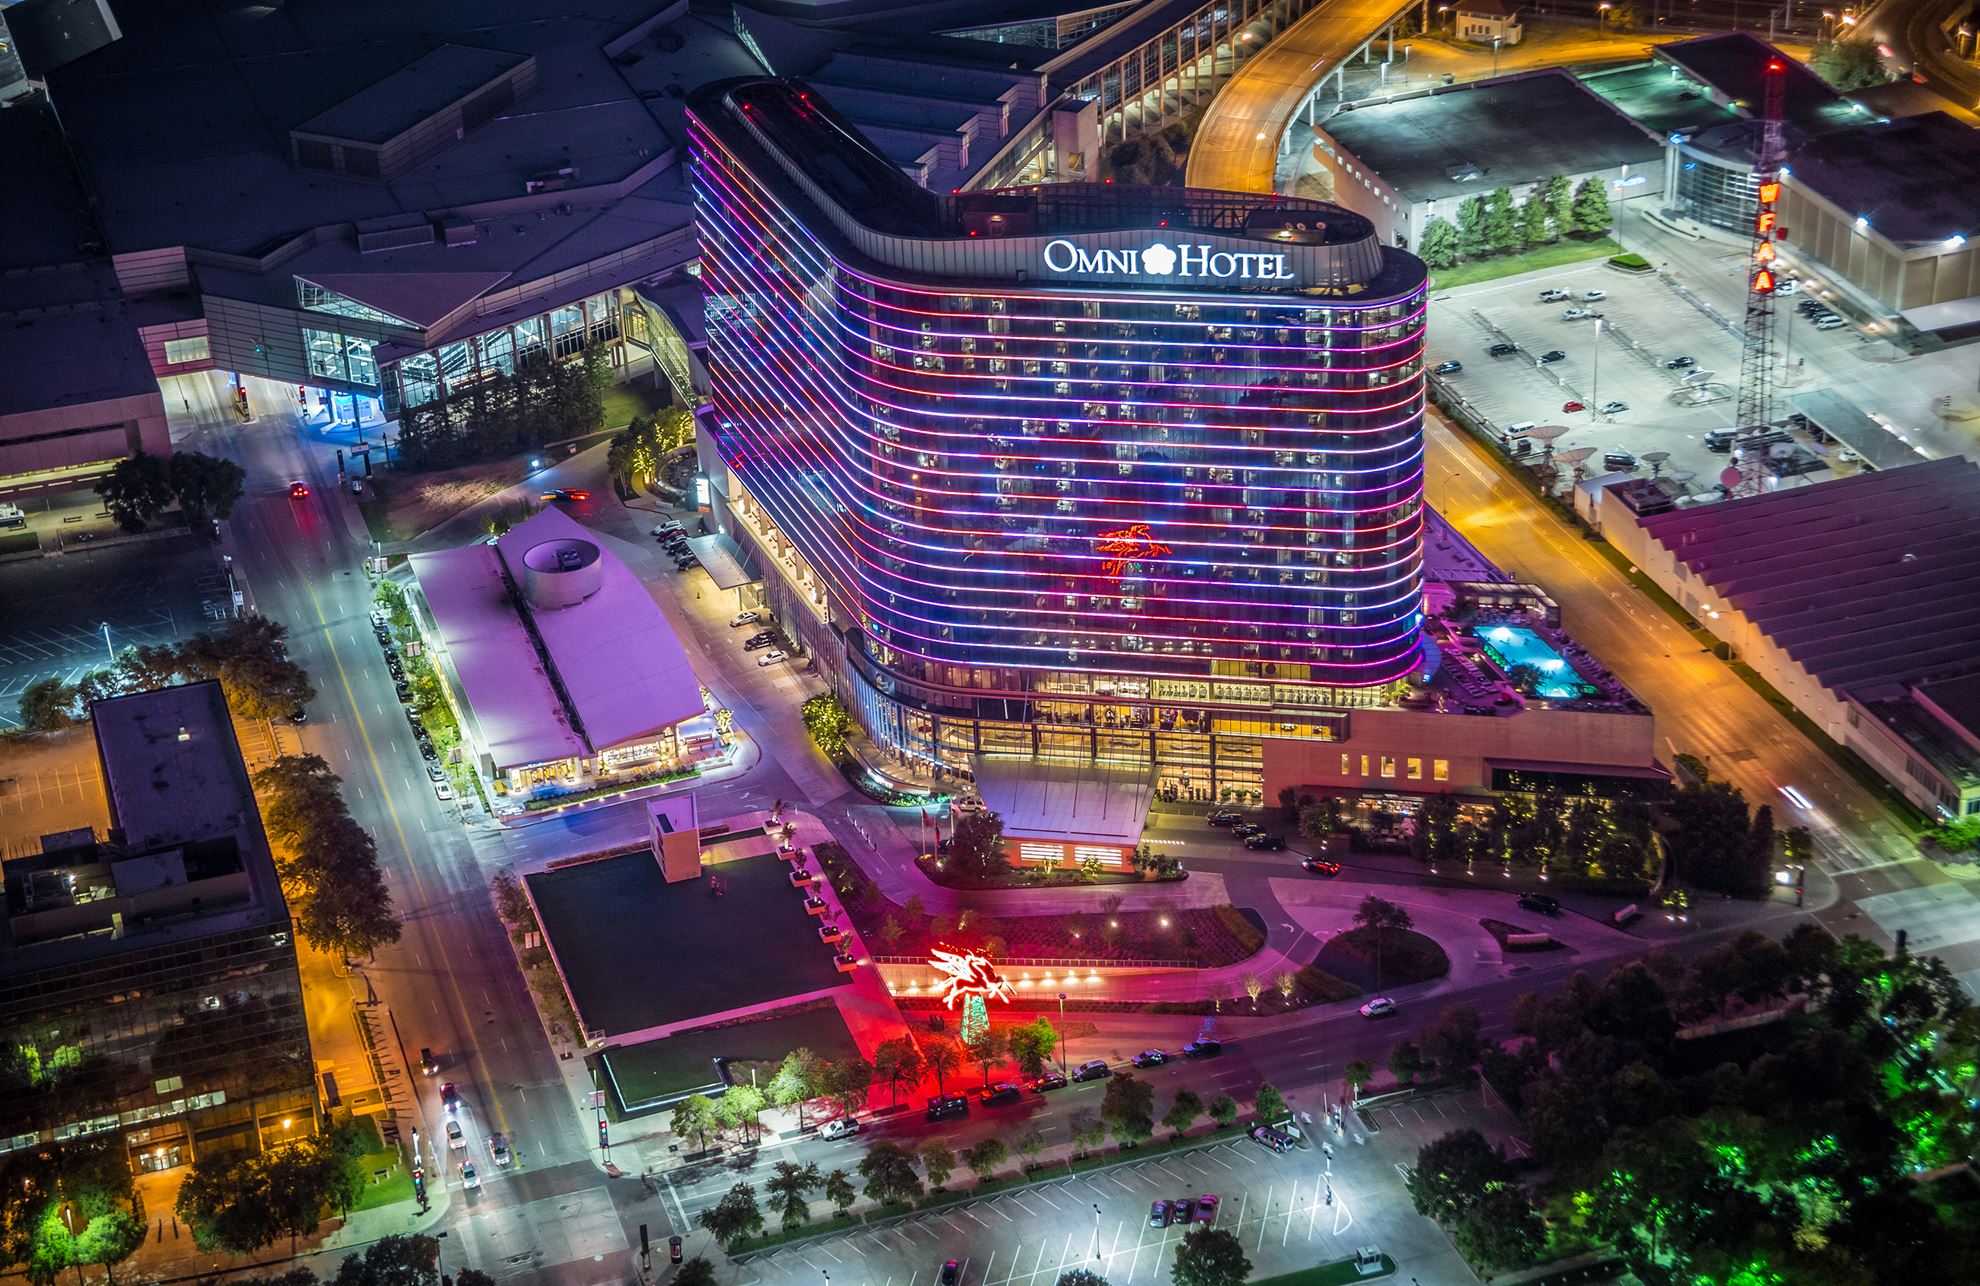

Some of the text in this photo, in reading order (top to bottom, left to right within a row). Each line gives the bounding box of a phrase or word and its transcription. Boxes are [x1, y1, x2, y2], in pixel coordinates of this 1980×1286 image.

[1043, 239, 1295, 280] OMNI HOTEL
[1755, 182, 1780, 290] WFAA
